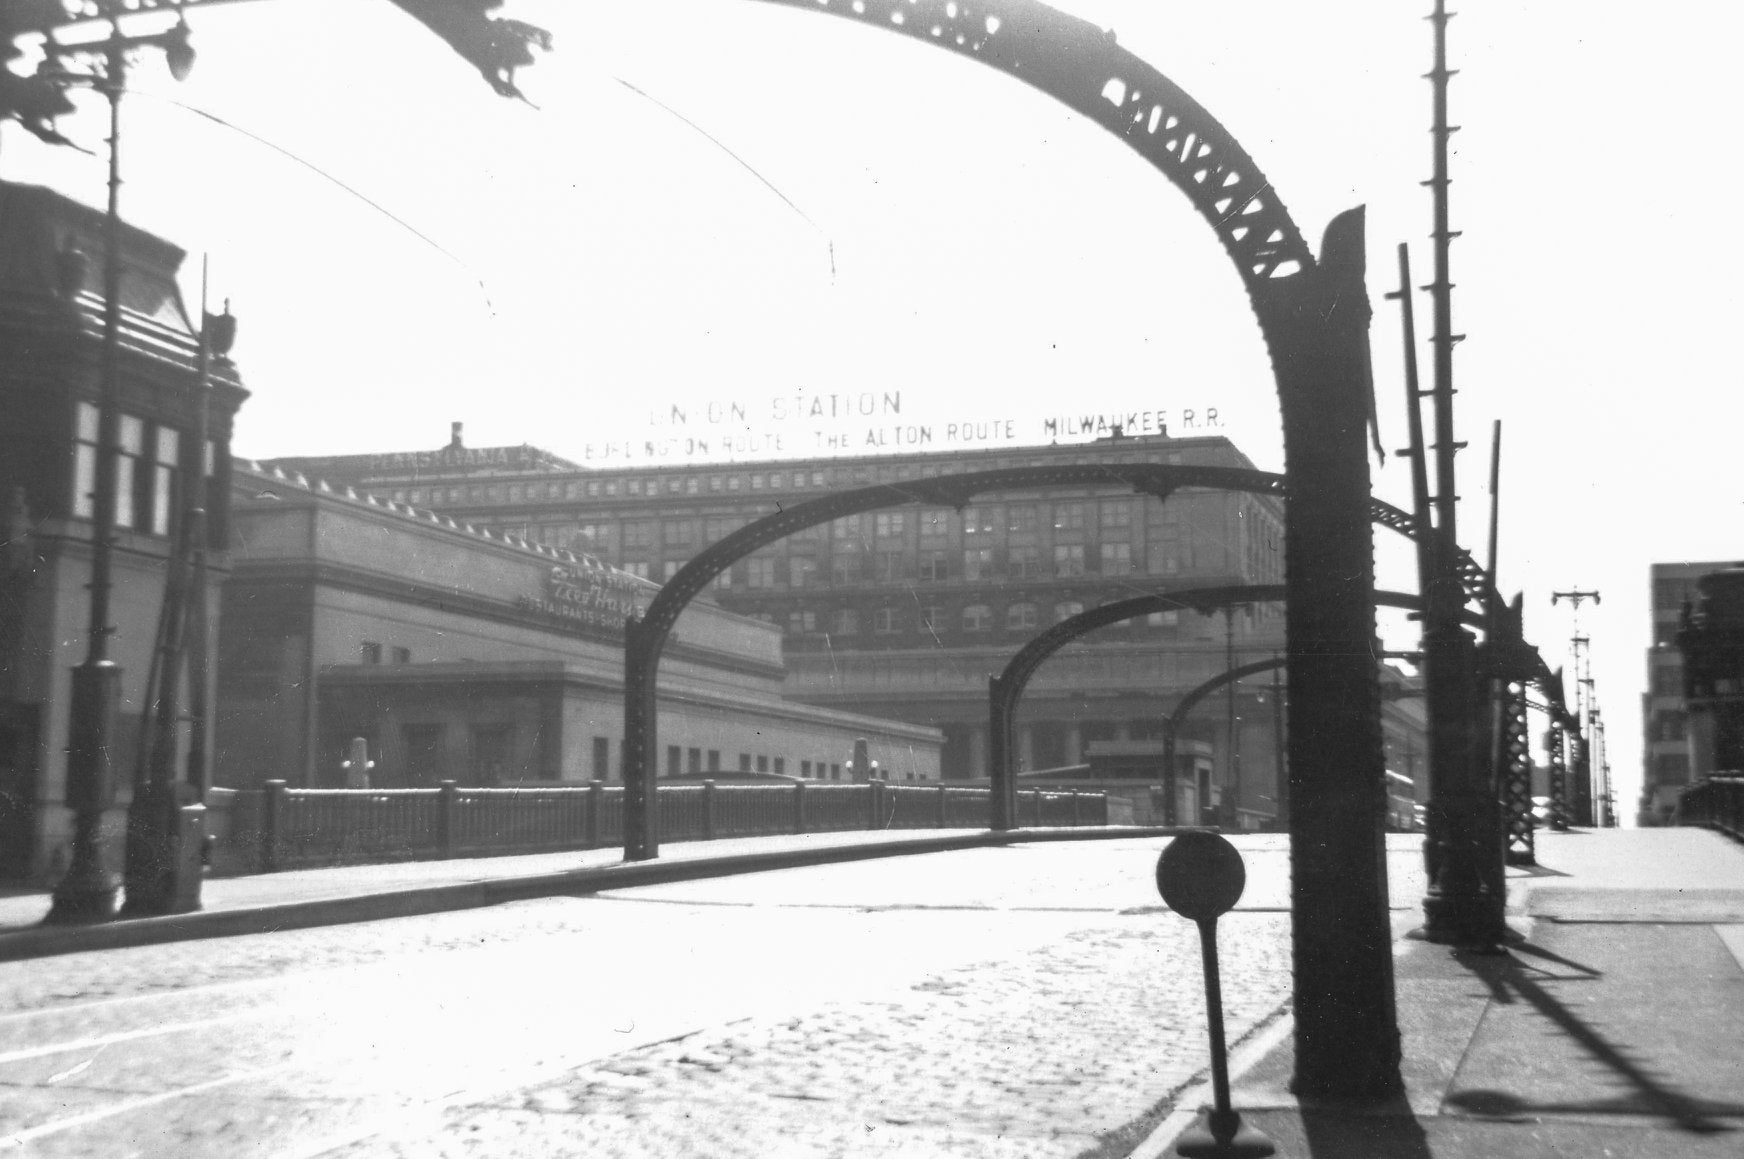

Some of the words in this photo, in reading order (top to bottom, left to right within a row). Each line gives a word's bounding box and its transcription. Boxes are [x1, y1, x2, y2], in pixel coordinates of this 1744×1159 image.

[649, 401, 746, 425] NON
[772, 390, 901, 420] STATION
[1043, 410, 1167, 436] MILWAUKEE
[1183, 407, 1226, 428] R.R.
[814, 431, 849, 449] THE
[865, 425, 932, 447] ALTON
[947, 419, 1016, 441] ROUTE
